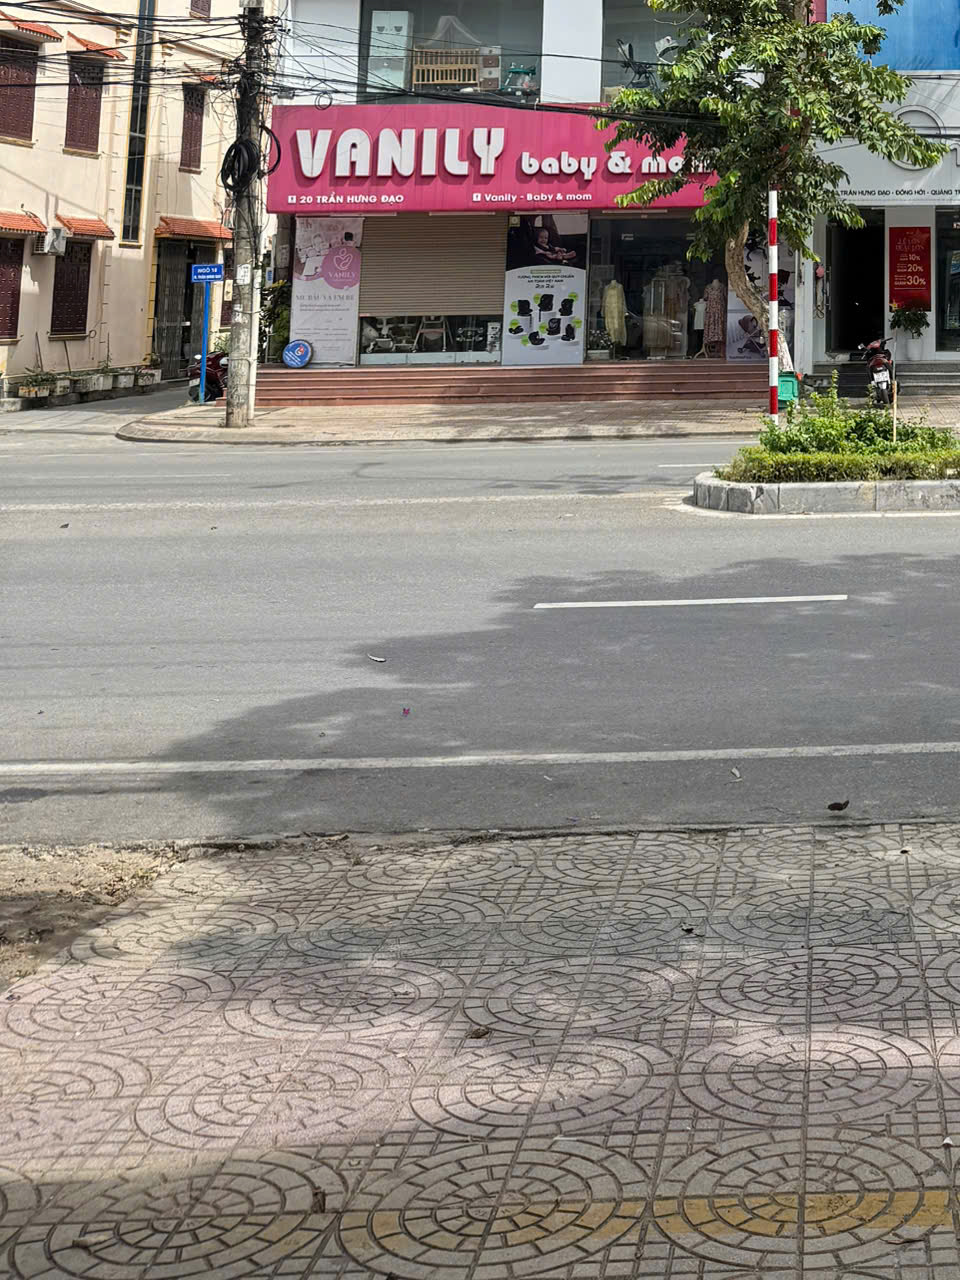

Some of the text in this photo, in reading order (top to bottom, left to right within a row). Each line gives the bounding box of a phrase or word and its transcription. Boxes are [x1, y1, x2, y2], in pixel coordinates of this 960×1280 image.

[296, 127, 505, 178] VANILY
[521, 151, 598, 180] baby
[607, 151, 631, 174] &
[300, 195, 313, 204] 20
[347, 195, 377, 203] HƯNG
[381, 194, 404, 206] ĐẠO
[484, 193, 517, 203] Vanily
[526, 192, 554, 202] Baby
[556, 193, 563, 201] &
[566, 193, 592, 201] mom
[907, 263, 924, 272] 20%
[906, 275, 927, 285] 30%
